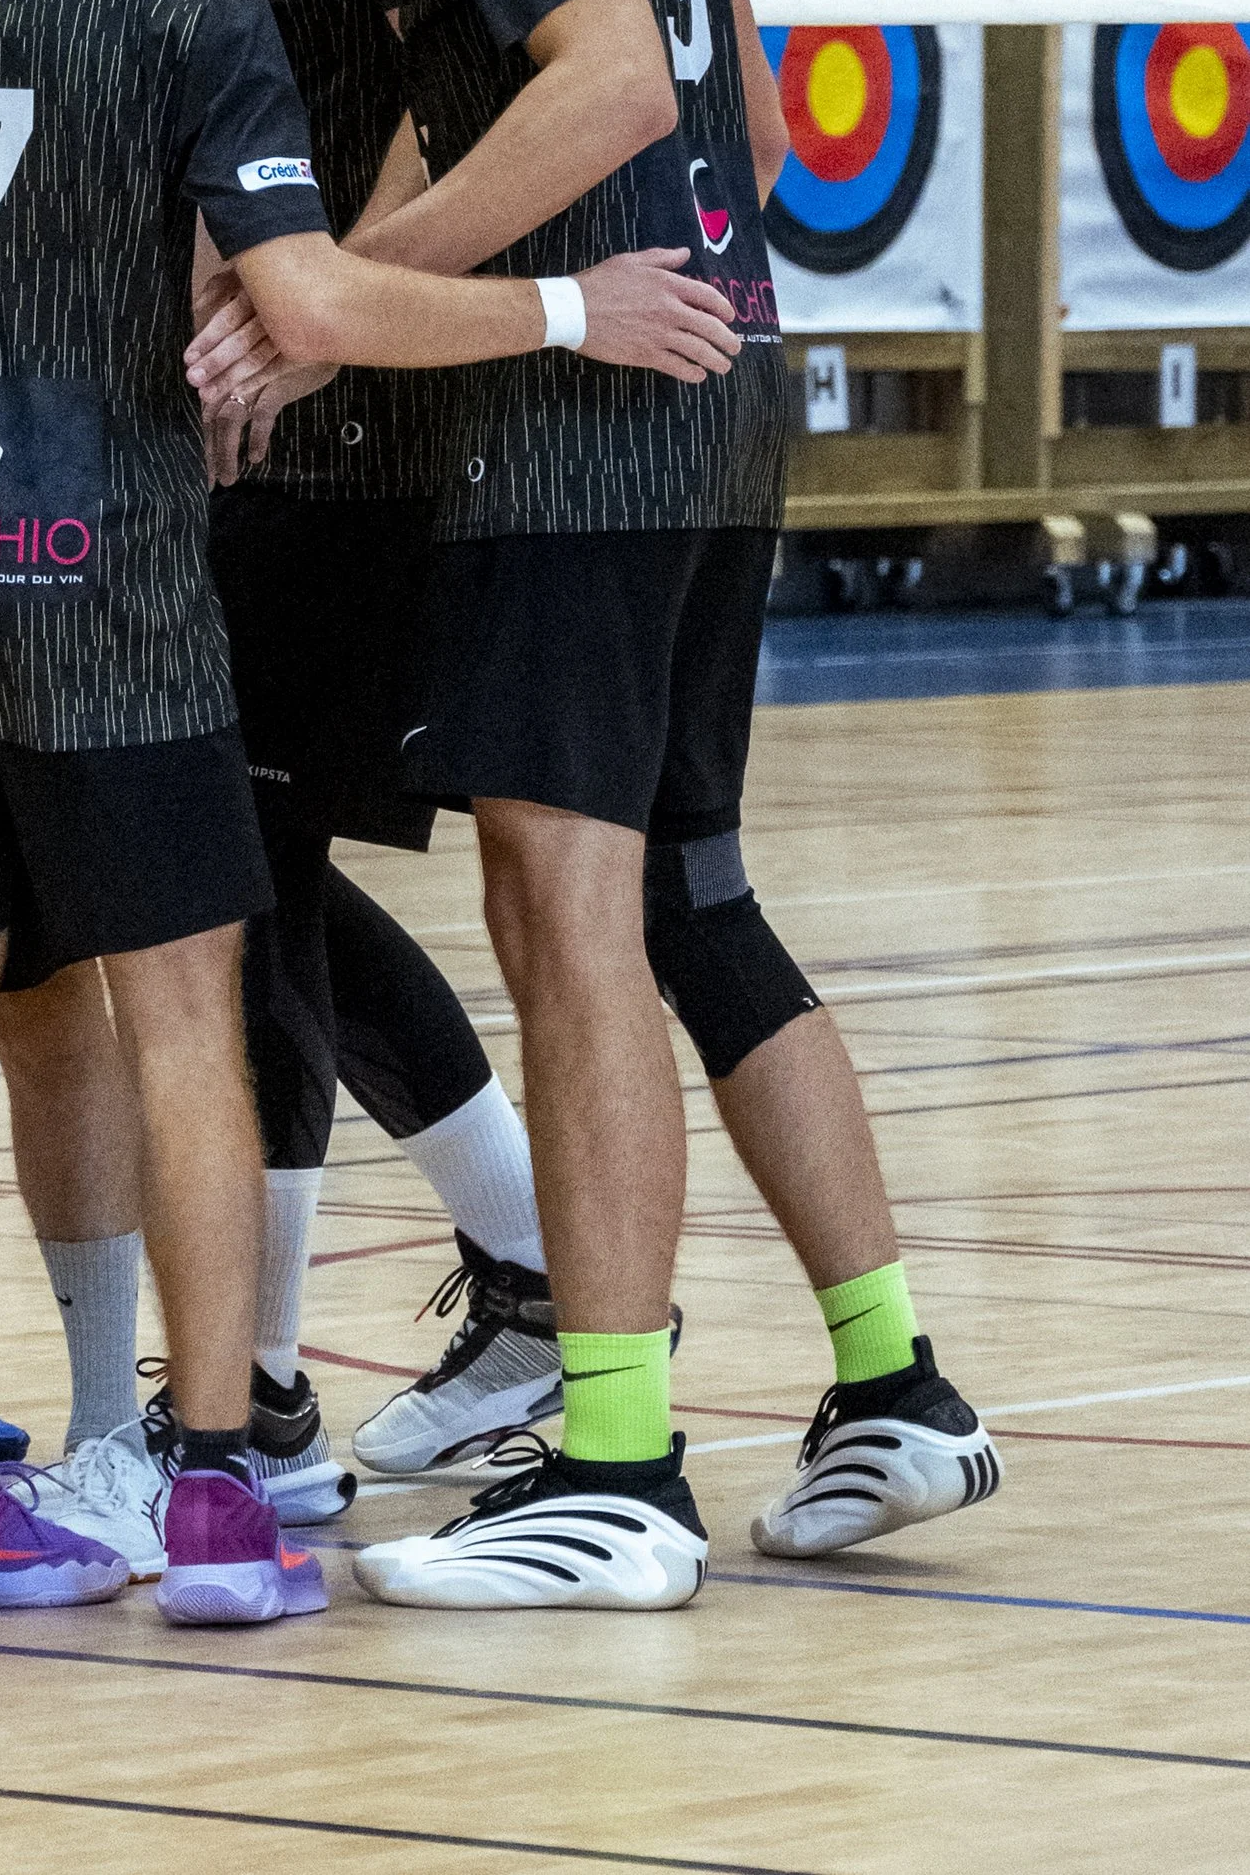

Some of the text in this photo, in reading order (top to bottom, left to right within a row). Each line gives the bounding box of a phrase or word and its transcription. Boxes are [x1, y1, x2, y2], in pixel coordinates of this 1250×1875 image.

[258, 162, 301, 180] Crédit
[812, 365, 837, 403] H
[32, 575, 53, 584] DU
[59, 575, 83, 584] VIN
